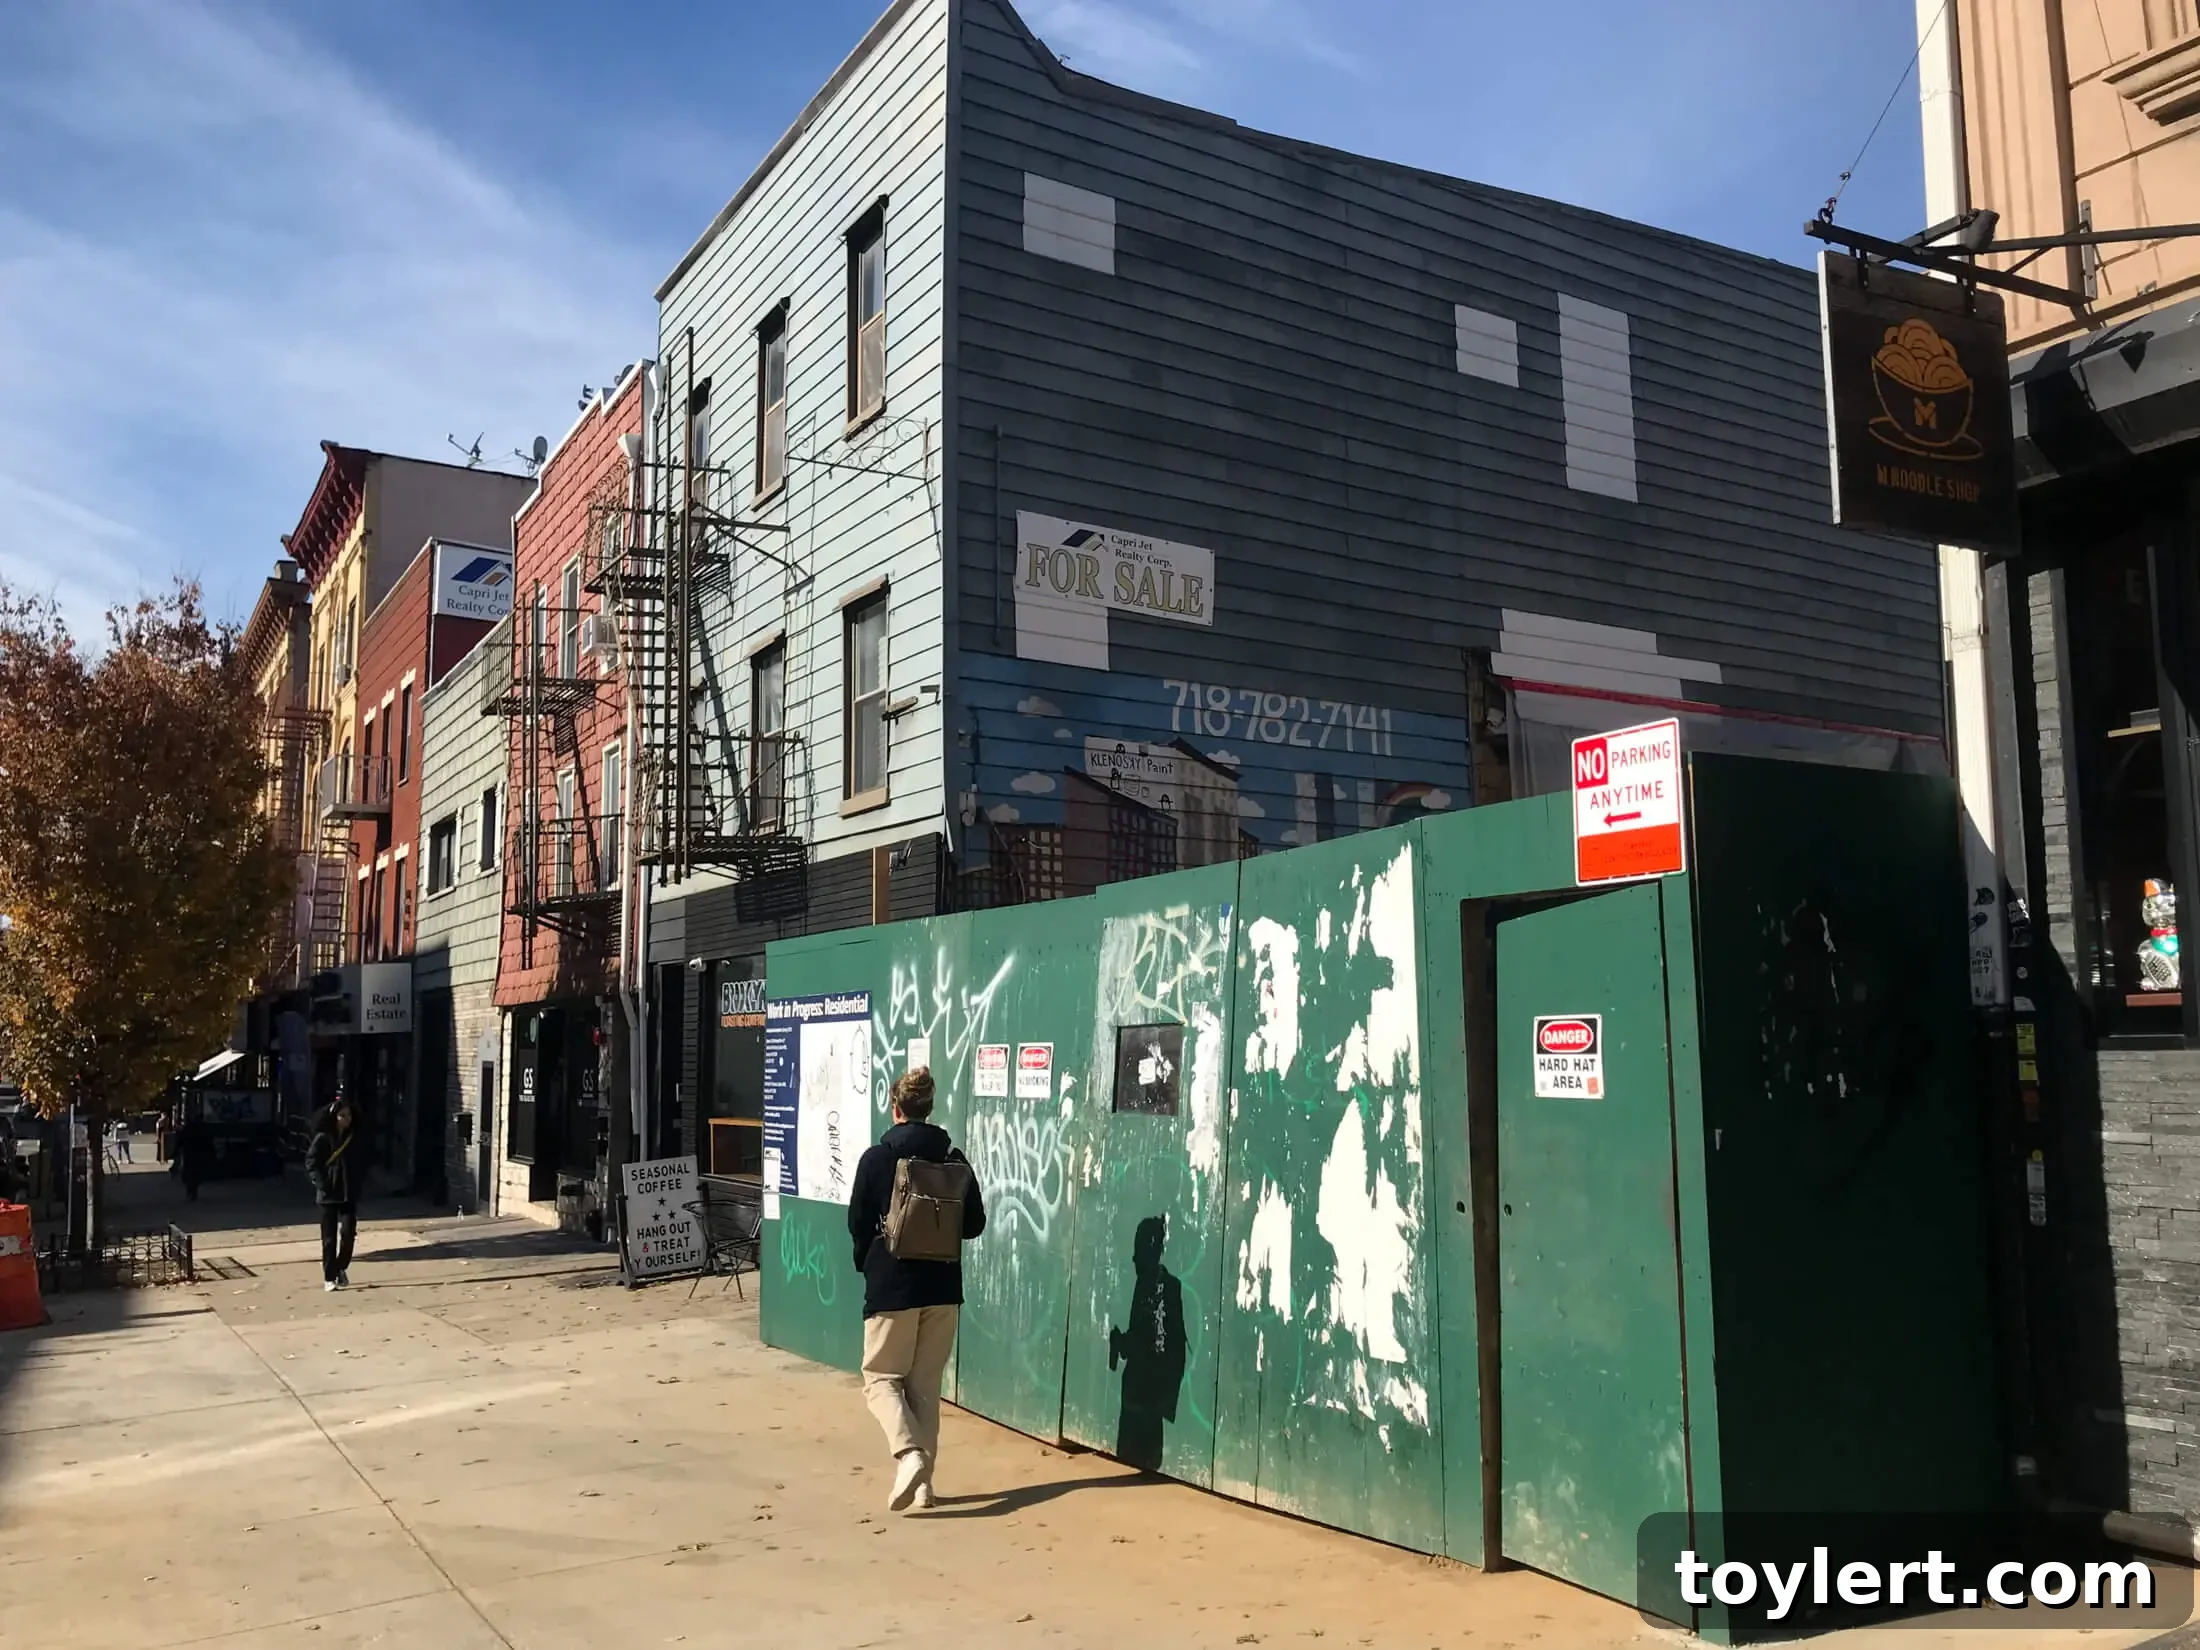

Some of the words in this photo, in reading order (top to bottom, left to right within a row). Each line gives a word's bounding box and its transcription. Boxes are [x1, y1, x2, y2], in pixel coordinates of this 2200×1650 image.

[1914, 398, 1936, 429] M
[1891, 467, 1943, 496] NOODLE
[1111, 534, 1137, 549] Capri
[1138, 540, 1152, 551] Jet
[1115, 549, 1145, 563] Realty
[1147, 555, 1172, 569] Corp.
[1025, 543, 1104, 599] FOR
[1114, 561, 1203, 617] SALE
[458, 584, 490, 600] Capri
[493, 589, 509, 601] Jet
[446, 598, 484, 616] Realty
[488, 605, 509, 615] Cor
[1164, 680, 1393, 756] 718-782-7141
[1147, 757, 1174, 775] Paint
[1577, 747, 1605, 783] NO
[1612, 741, 1671, 768] PARKING
[1590, 780, 1664, 809] ANYTIME
[372, 993, 400, 1005] Real
[767, 1002, 783, 1019] Work
[784, 1001, 791, 1017] in
[792, 1000, 823, 1020] Progress:
[824, 994, 868, 1015] Residential
[366, 1008, 407, 1020] Estate
[1544, 1029, 1588, 1044] DANGER
[1539, 1058, 1568, 1071] HARD
[1573, 1058, 1596, 1072] HAT
[1553, 1075, 1583, 1088] AREA
[631, 1164, 690, 1181] SEASONAL
[637, 1178, 682, 1195] COFFEE
[637, 1225, 666, 1240] HANG
[669, 1221, 691, 1234] OUT
[653, 1236, 690, 1252] TREAT
